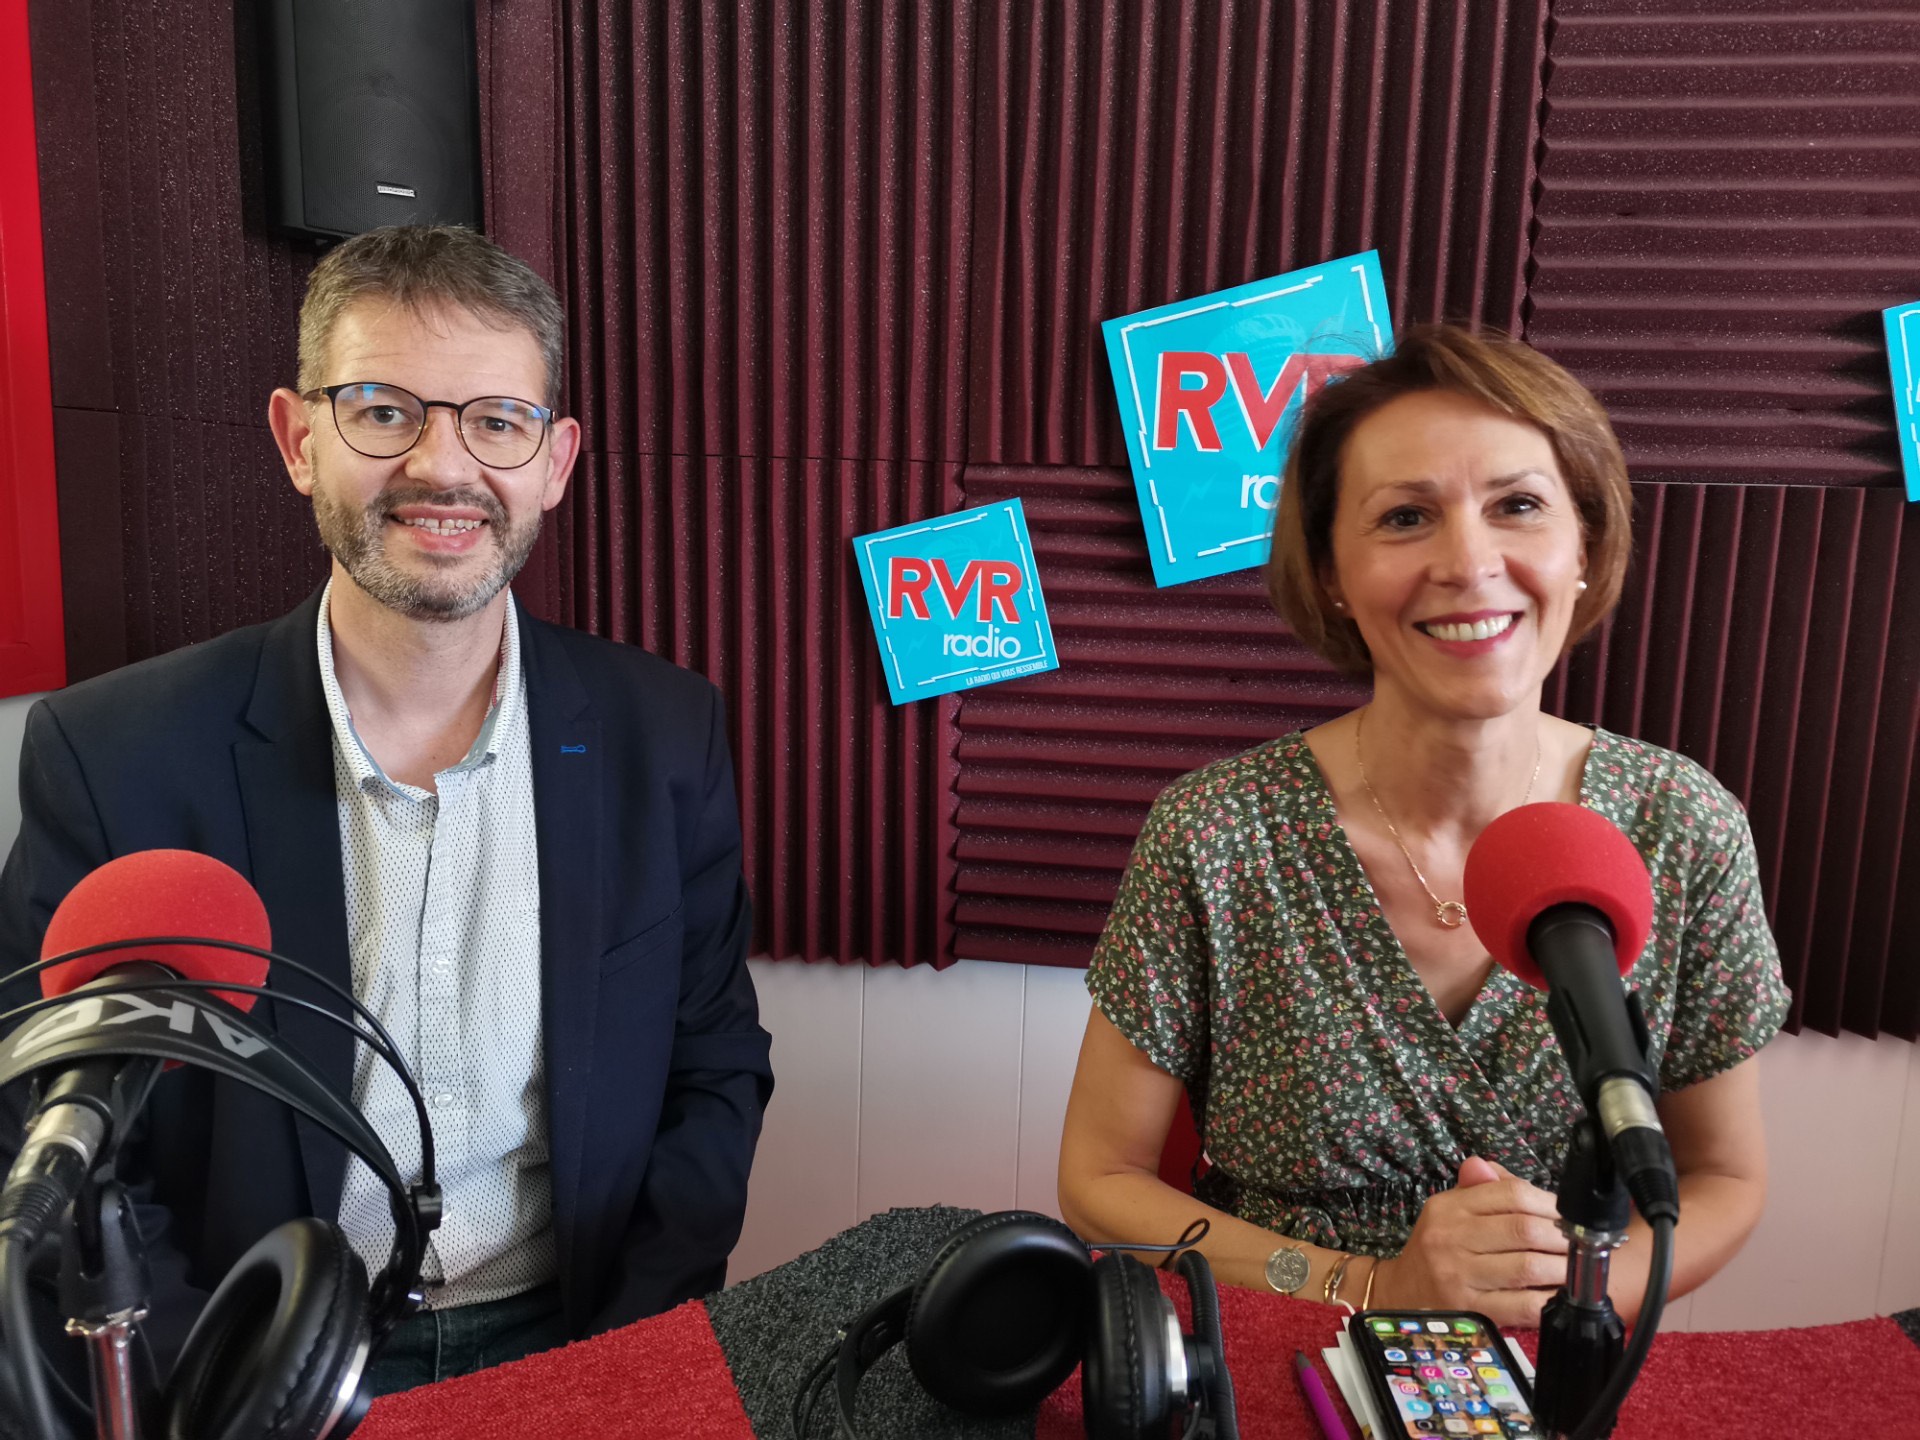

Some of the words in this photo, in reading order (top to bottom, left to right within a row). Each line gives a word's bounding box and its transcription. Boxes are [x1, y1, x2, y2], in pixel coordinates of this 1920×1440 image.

[887, 556, 1022, 624] RVR
[943, 624, 1021, 658] radio
[974, 673, 991, 684] RADIO
[11, 993, 269, 1059] AKG
